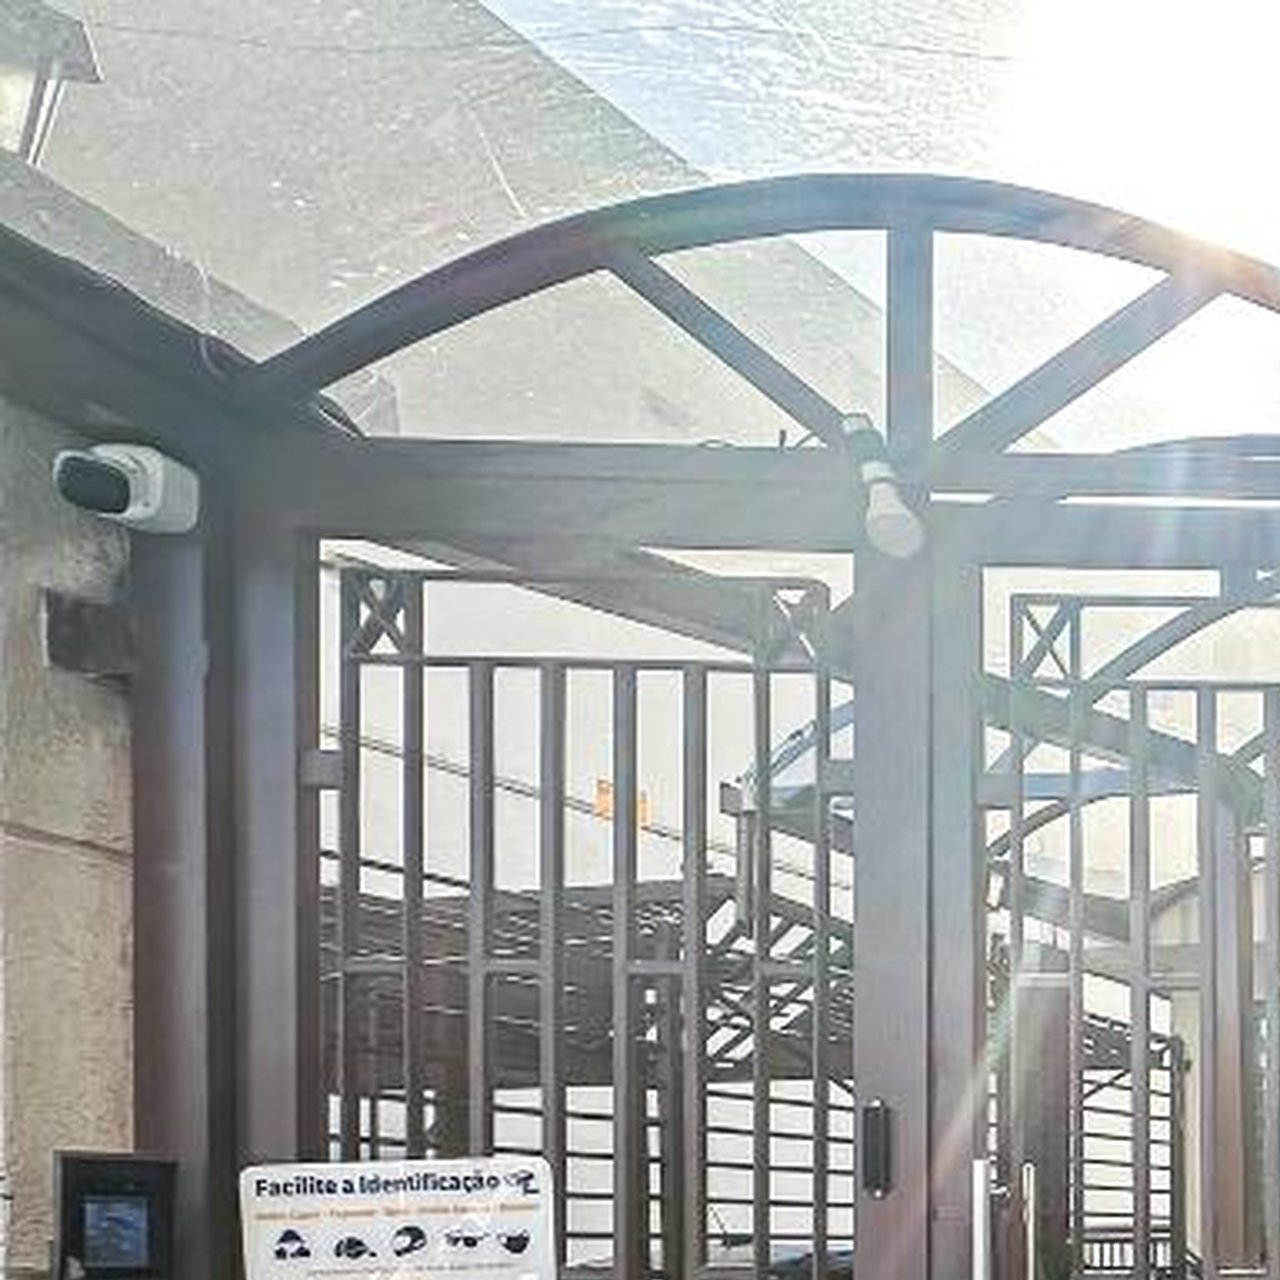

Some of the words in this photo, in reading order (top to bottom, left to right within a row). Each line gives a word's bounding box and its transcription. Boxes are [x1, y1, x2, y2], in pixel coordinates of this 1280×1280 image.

[255, 1176, 338, 1196] Facilite
[341, 1179, 354, 1194] a
[359, 1169, 500, 1194] Identificação
